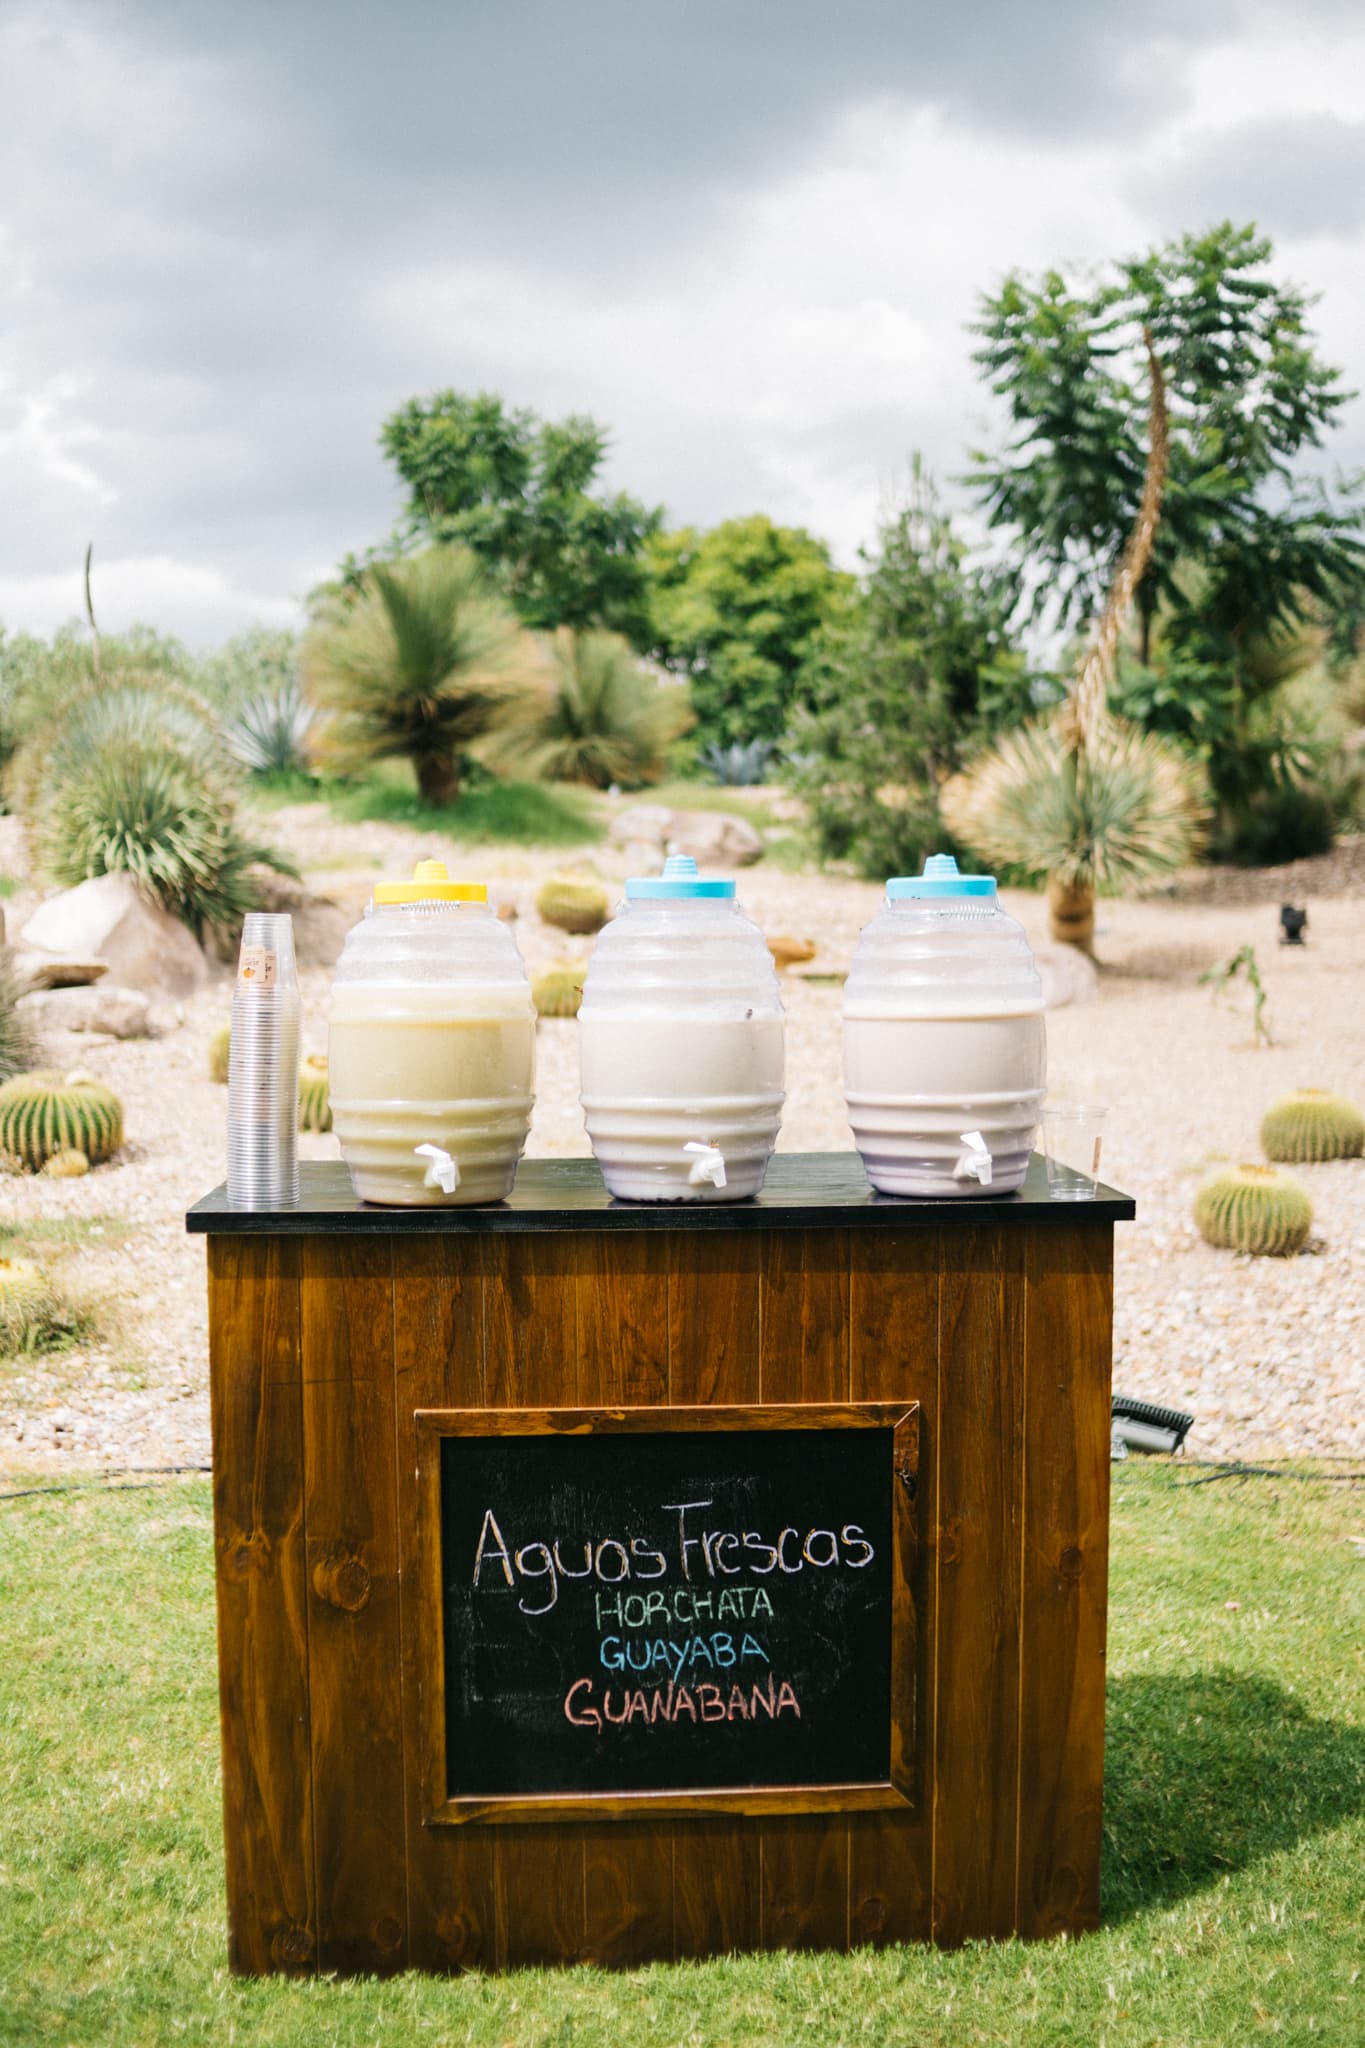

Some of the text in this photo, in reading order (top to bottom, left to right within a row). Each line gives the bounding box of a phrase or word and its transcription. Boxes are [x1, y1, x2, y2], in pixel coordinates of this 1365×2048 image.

[473, 1499, 875, 1615] Aguas Frescas
[595, 1586, 775, 1631] HORCHATA
[599, 1631, 770, 1683] GUAYABA
[564, 1671, 802, 1736] GUANABANA
